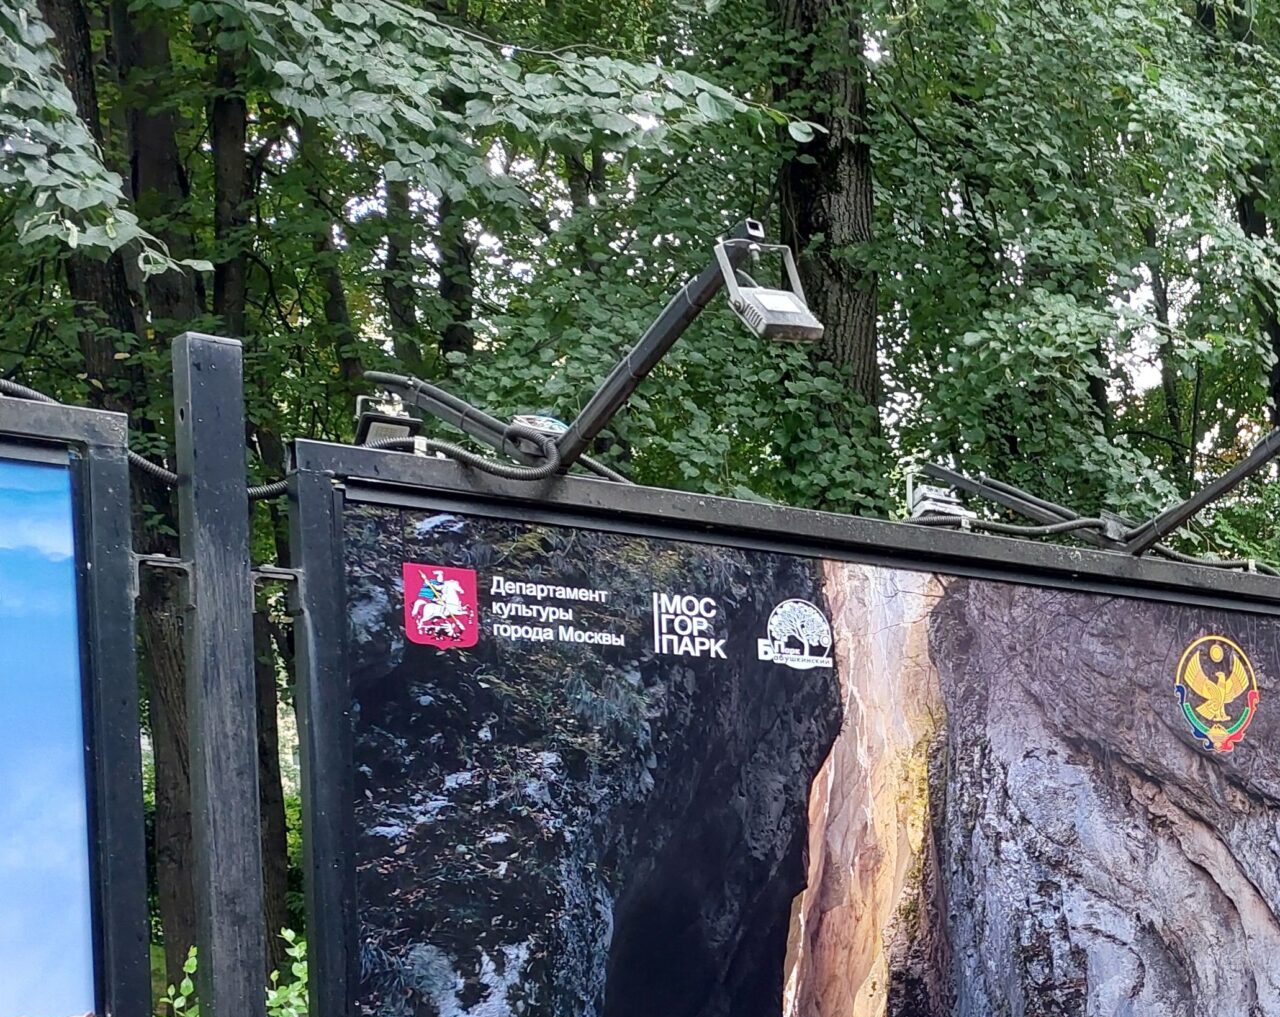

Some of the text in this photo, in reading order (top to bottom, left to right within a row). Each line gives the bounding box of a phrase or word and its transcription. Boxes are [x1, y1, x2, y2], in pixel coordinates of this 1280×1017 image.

[490, 575, 608, 603] Департамент
[491, 601, 573, 623] культуры
[660, 593, 717, 618] МОС
[493, 623, 626, 647] города Москвы
[661, 614, 709, 636] ГОР
[661, 634, 728, 660] ПАРК
